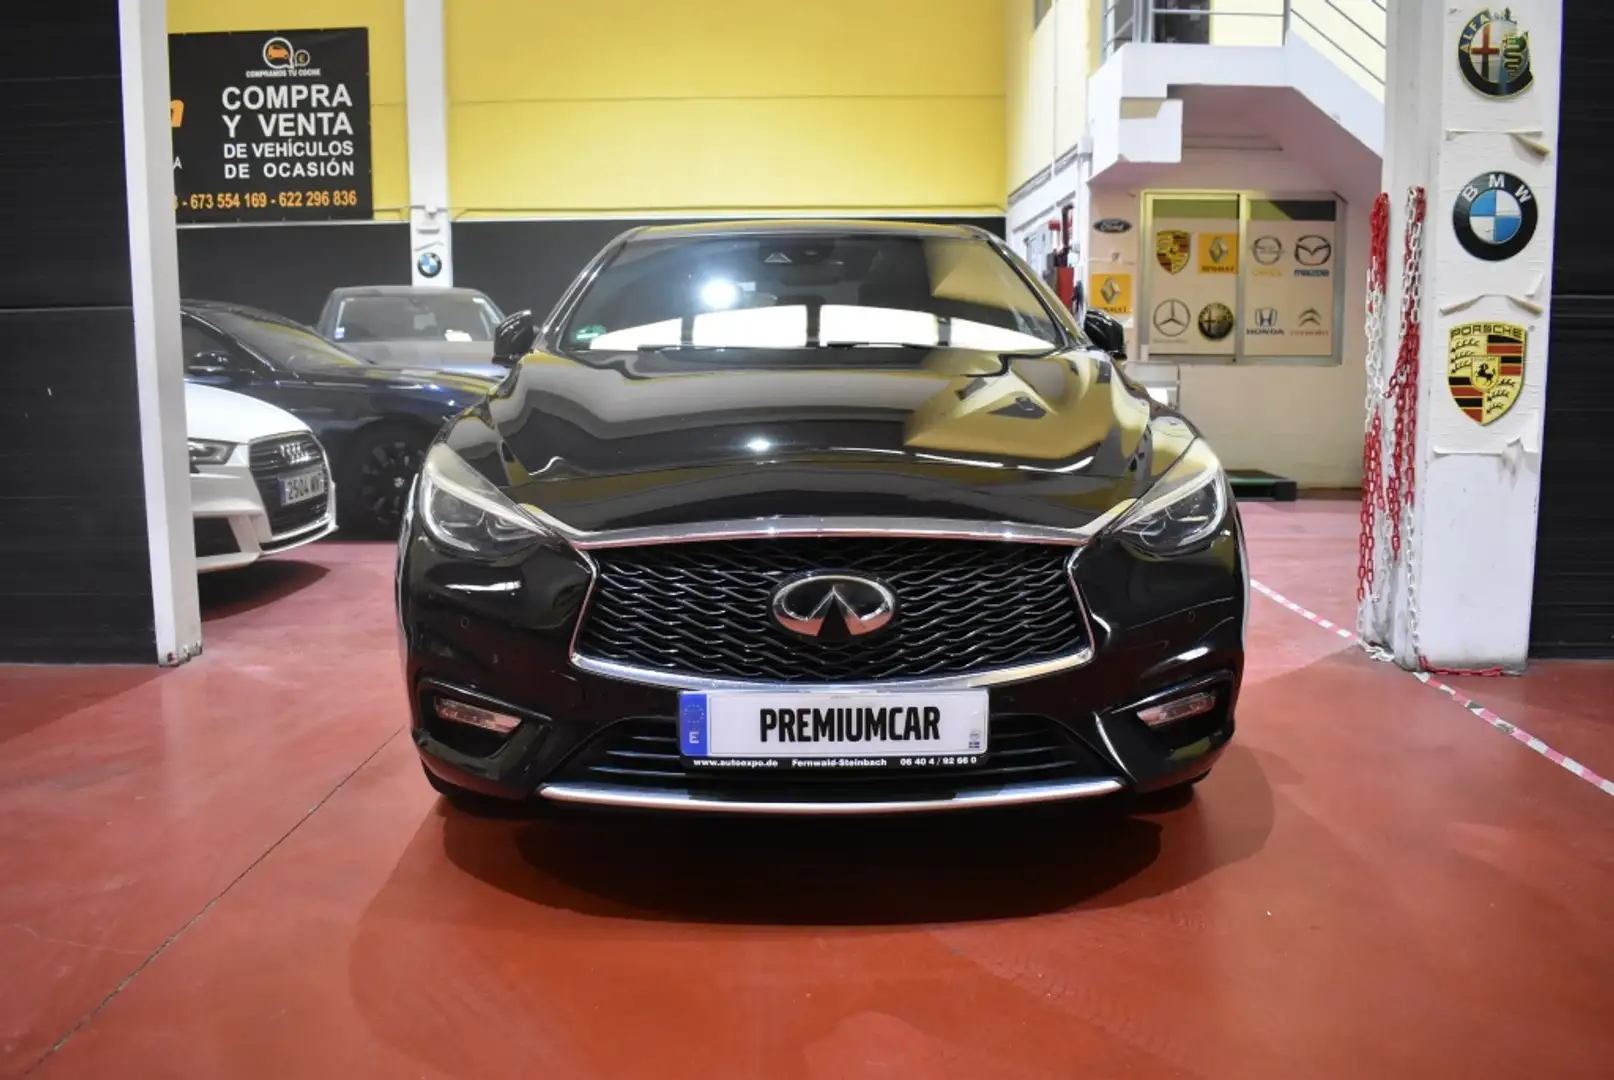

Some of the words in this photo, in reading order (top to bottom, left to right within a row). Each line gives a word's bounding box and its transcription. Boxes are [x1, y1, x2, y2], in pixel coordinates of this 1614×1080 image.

[245, 69, 287, 78] COMPRAMOS
[288, 69, 297, 77] TU
[298, 67, 321, 77] COCHE
[221, 83, 353, 111] COMPRA
[221, 114, 242, 138] Y
[257, 112, 354, 137] VENTA
[223, 143, 248, 159] DE
[251, 138, 354, 159] VEHÍCULOS
[224, 163, 250, 179] DE
[263, 158, 355, 179] OCASIÓN
[1461, 173, 1532, 204] BMW
[190, 193, 214, 209] 673
[216, 192, 241, 208] 554
[244, 192, 268, 208] 169
[279, 191, 303, 208] 622
[305, 191, 329, 207] 296
[332, 190, 357, 206] 836
[1451, 324, 1524, 339] PORSCHE
[760, 706, 941, 743] PREMIUMCAR
[688, 731, 700, 745] E
[900, 758, 913, 766] 06
[914, 757, 927, 766] 40
